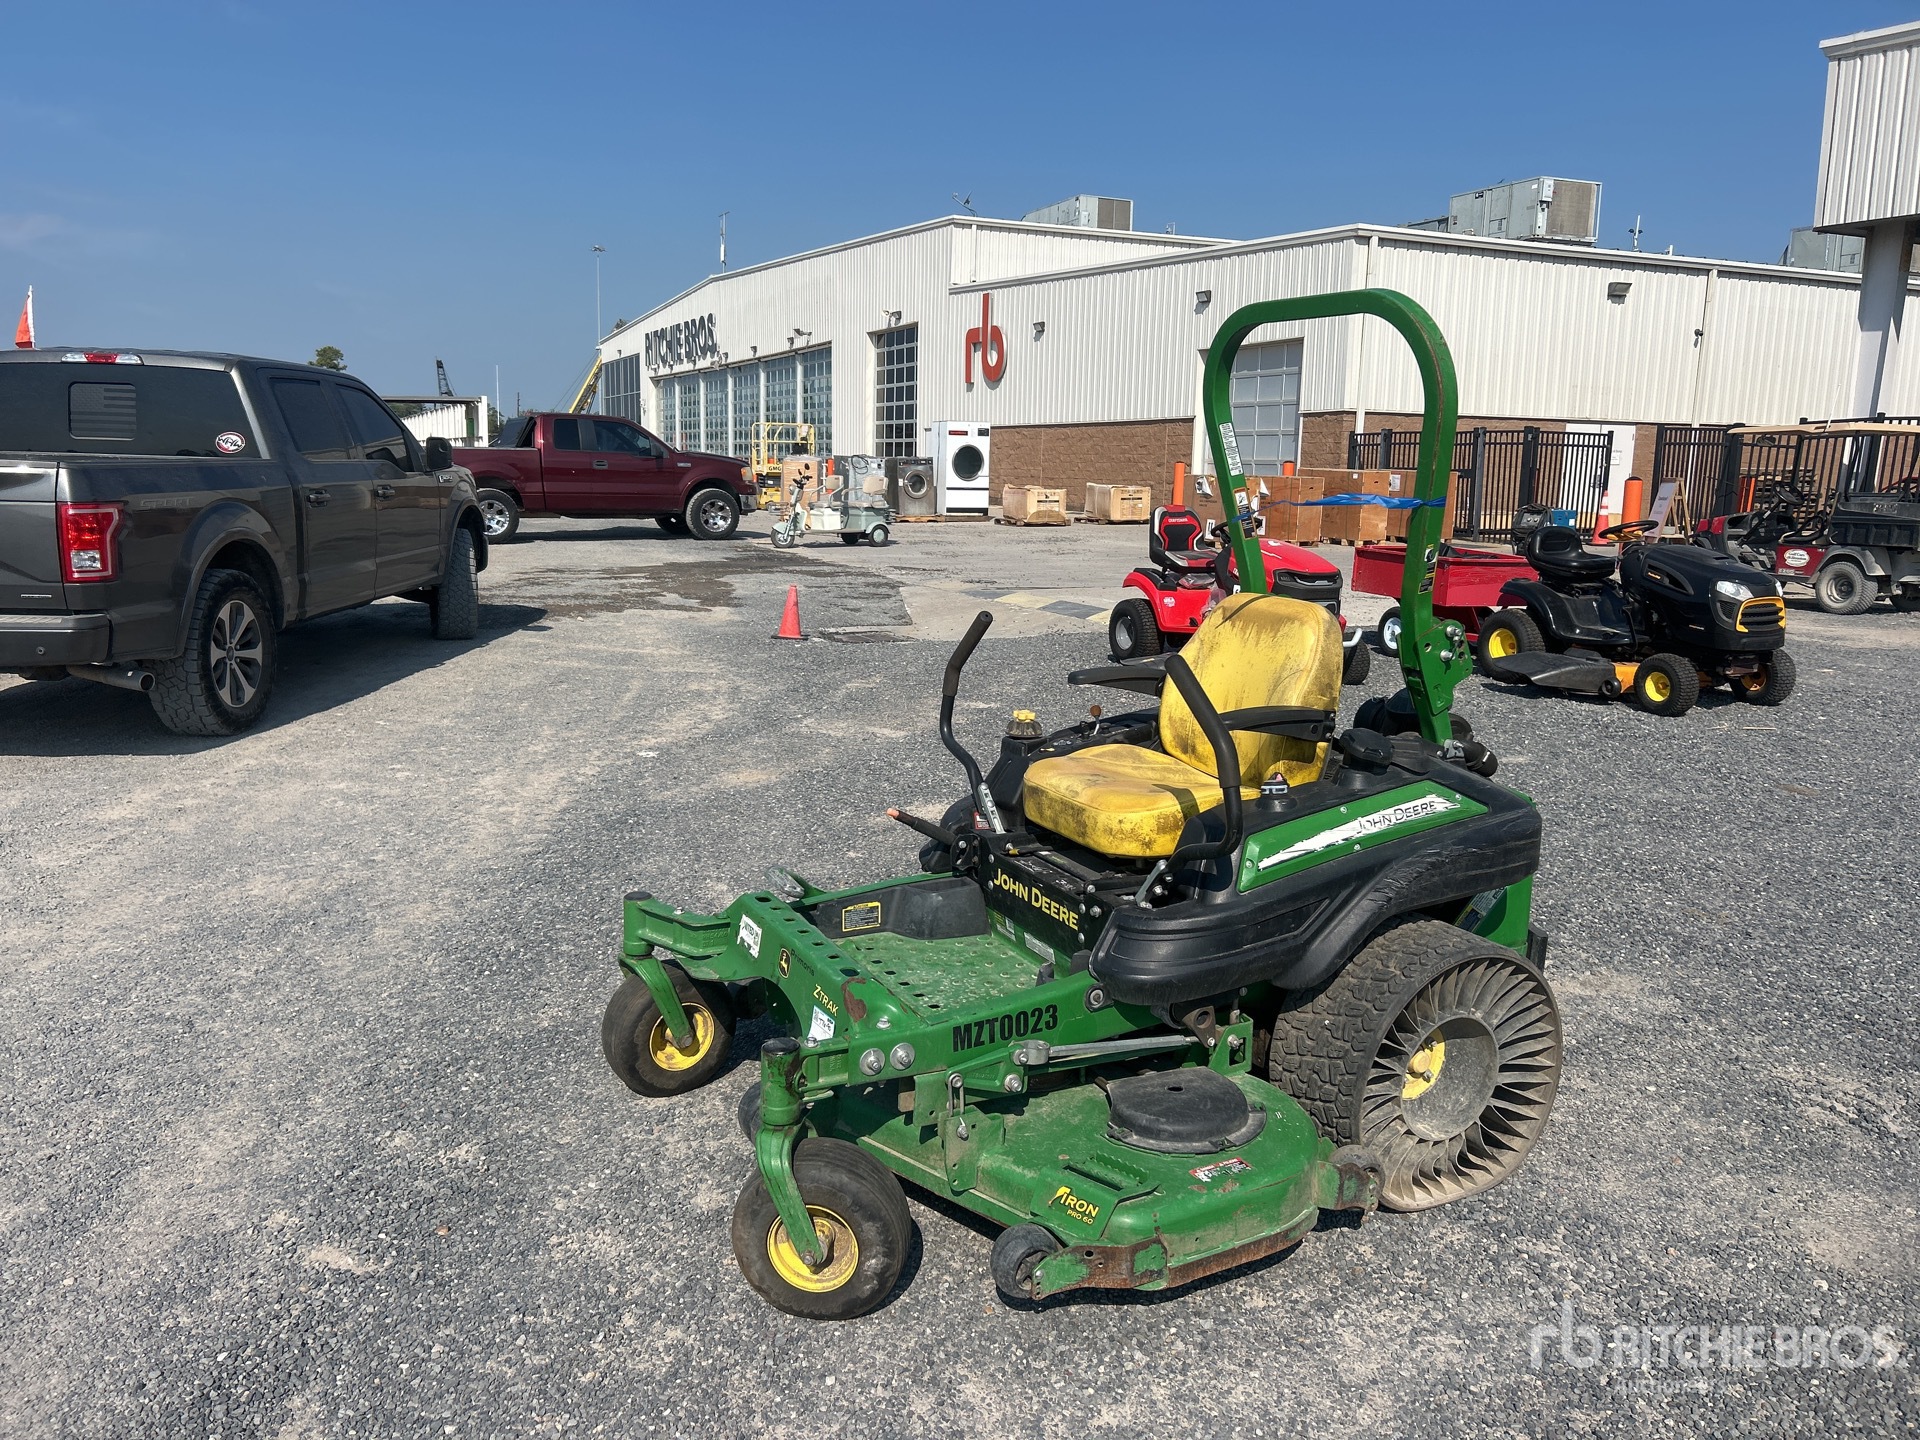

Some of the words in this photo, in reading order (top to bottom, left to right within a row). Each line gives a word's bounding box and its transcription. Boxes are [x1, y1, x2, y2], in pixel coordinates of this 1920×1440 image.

[645, 323, 683, 367] RITCHIE
[965, 292, 1004, 383] rb
[1356, 814, 1392, 834] JOHN
[1393, 800, 1437, 821] DEERE
[993, 868, 1028, 902] JOHN
[1031, 886, 1079, 931] DEERE
[952, 1003, 1059, 1053] MZT0023
[1066, 1209, 1082, 1220] PRO
[1082, 1216, 1094, 1225] 60
